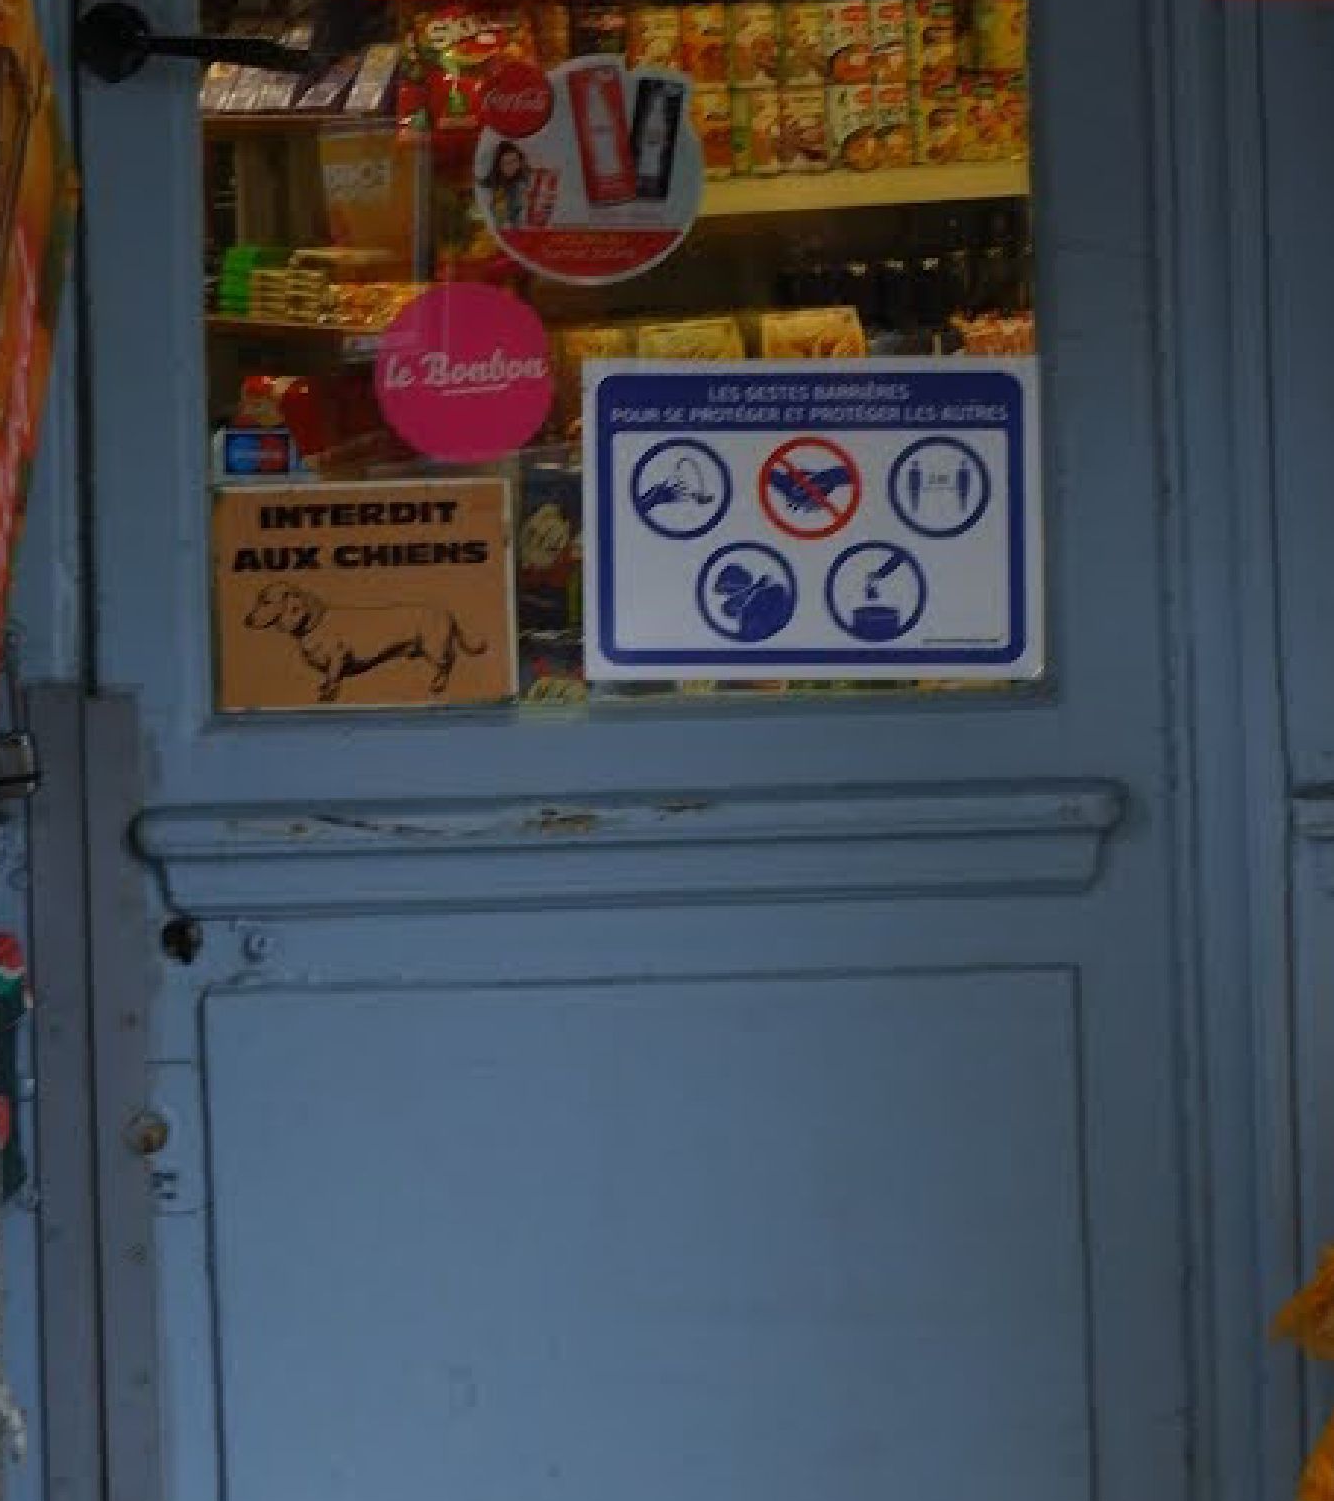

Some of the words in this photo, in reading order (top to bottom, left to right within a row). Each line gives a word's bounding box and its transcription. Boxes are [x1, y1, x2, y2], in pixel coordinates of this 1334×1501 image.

[384, 358, 415, 390] le
[419, 345, 548, 388] Bonbon
[707, 383, 741, 402] LES
[611, 405, 661, 423] POUR
[259, 501, 458, 530] INTERDIT
[233, 547, 321, 573] AUX
[332, 541, 489, 570] CHIENS
